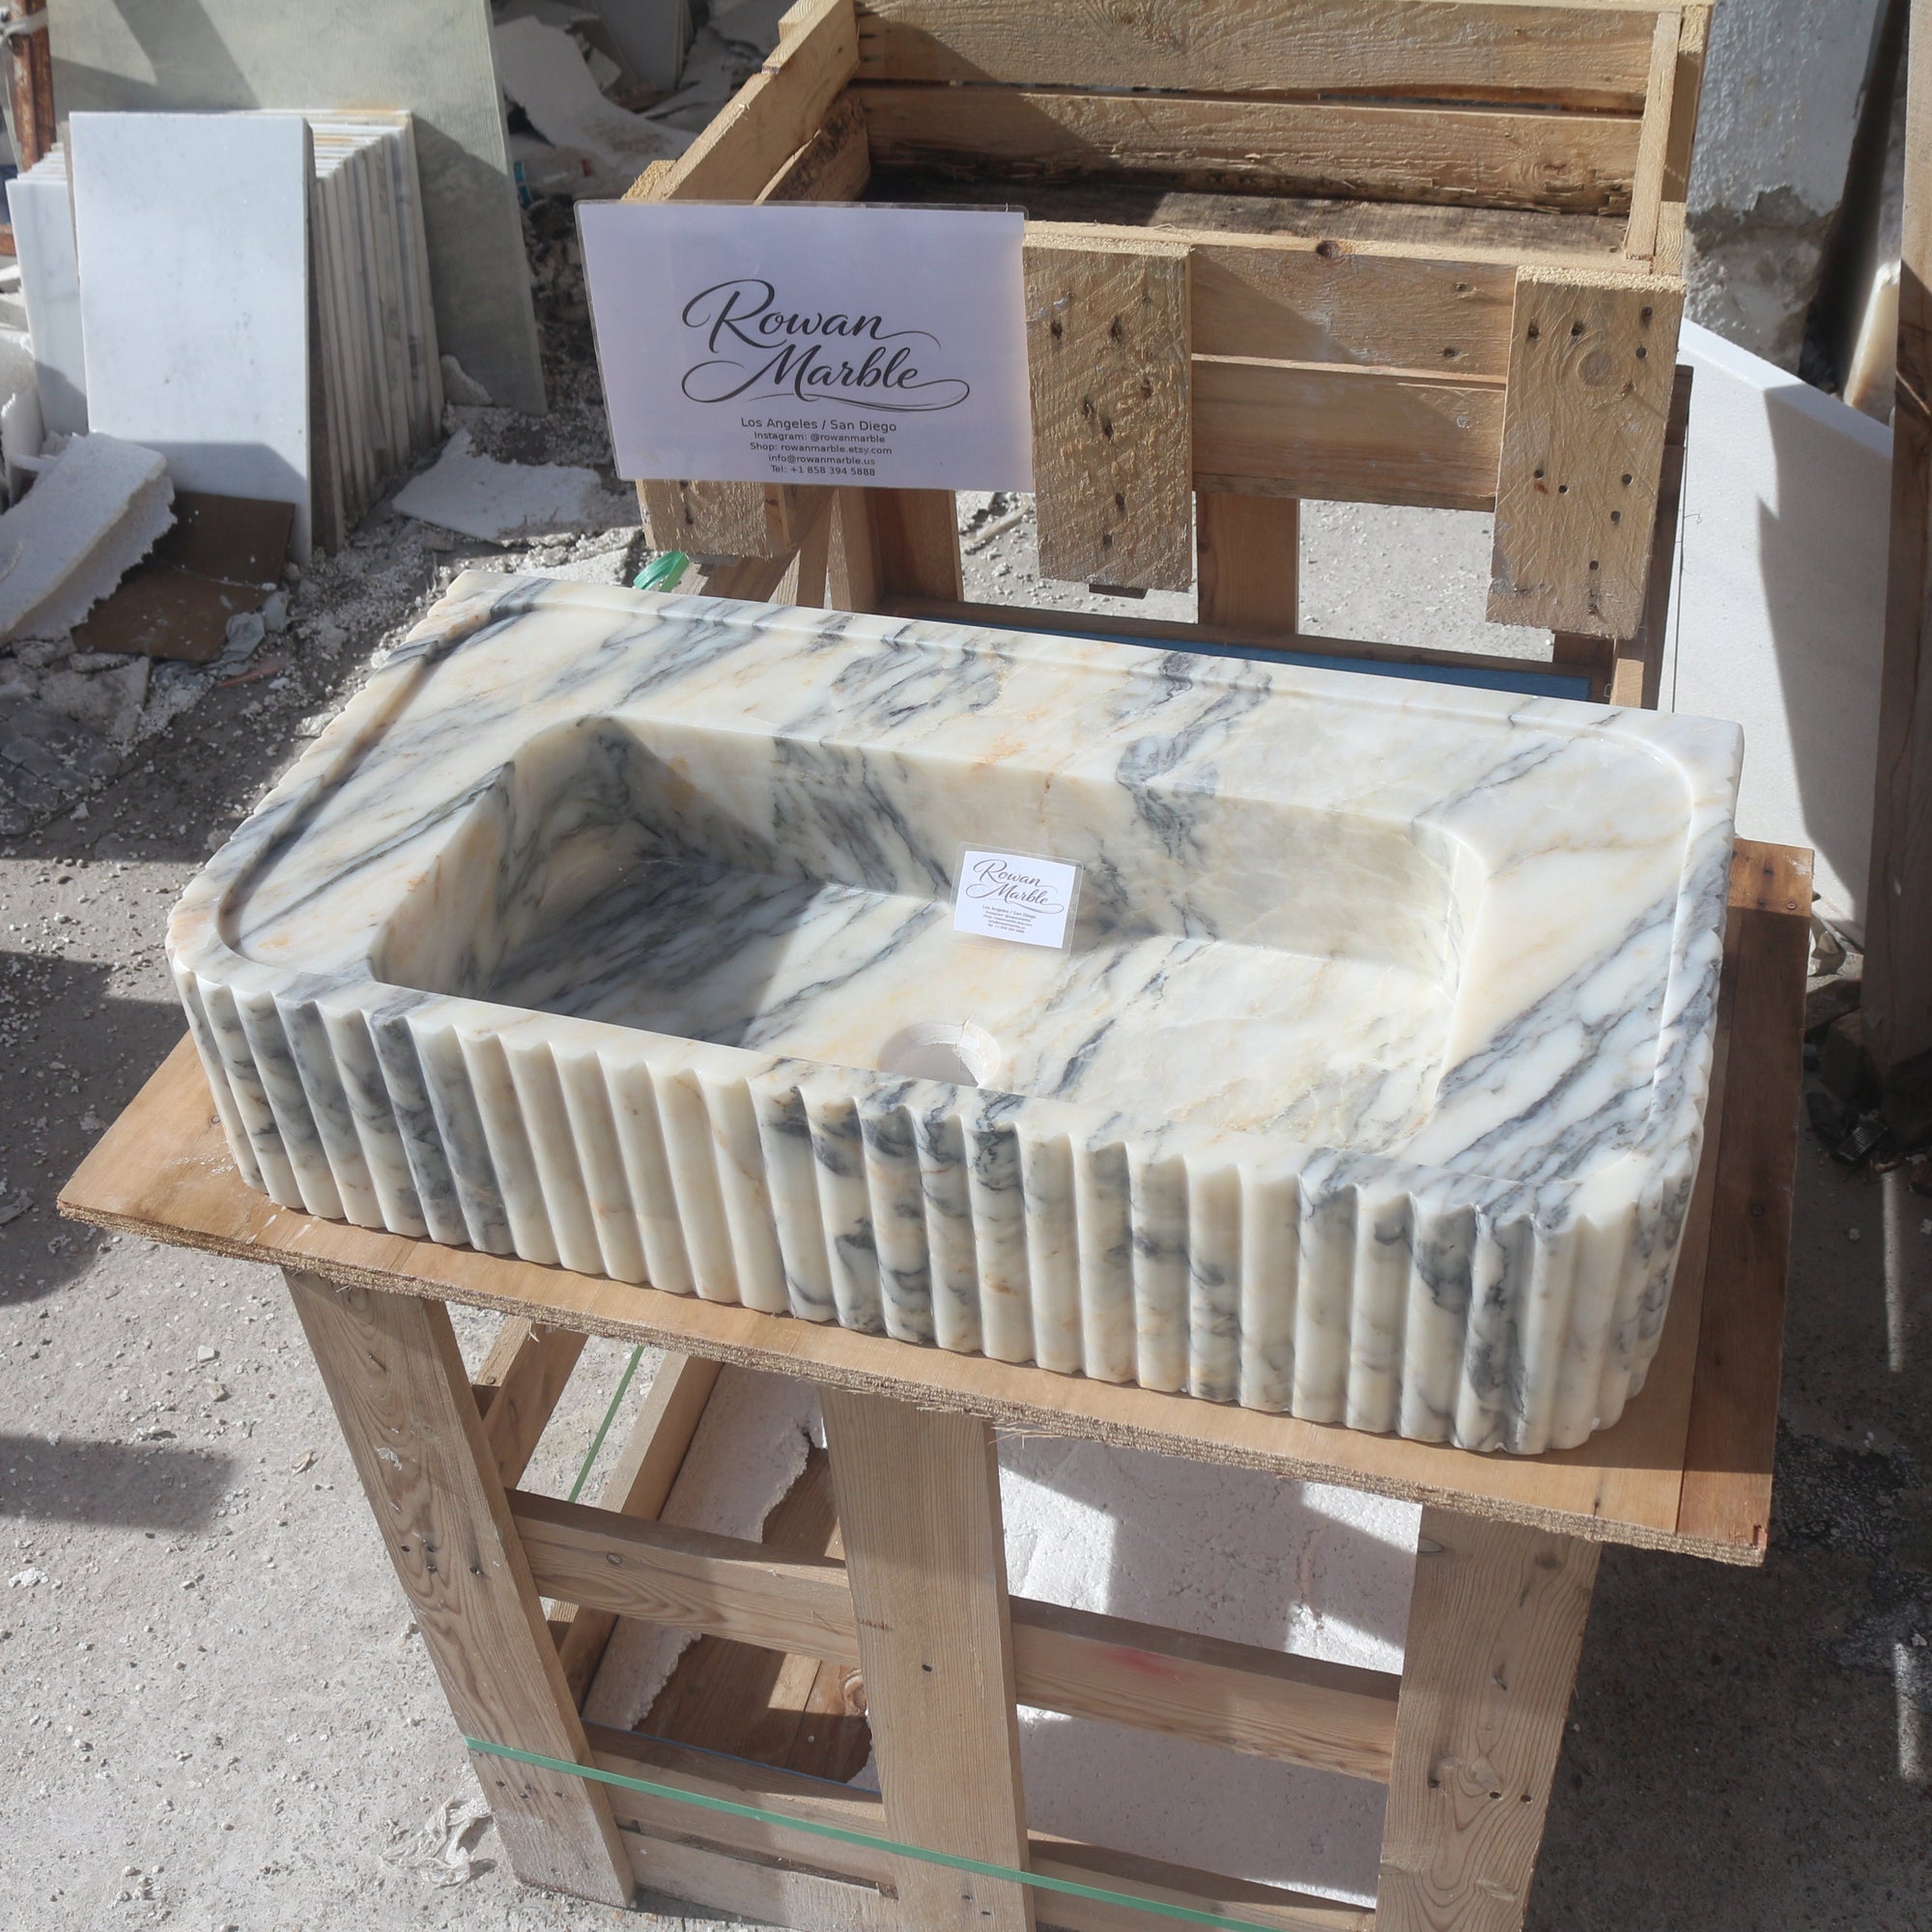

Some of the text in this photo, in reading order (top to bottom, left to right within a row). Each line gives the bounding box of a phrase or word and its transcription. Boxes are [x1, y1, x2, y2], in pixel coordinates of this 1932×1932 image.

[682, 278, 941, 354] Rowan
[681, 344, 970, 412] Marble
[741, 417, 897, 434] Los Angeles / San Diego
[753, 431, 886, 443] Instagram: @rowanmarble
[750, 442, 893, 455] Shop: rowanmarble.etsy.com
[768, 454, 876, 466] info@rowanmarble.us
[770, 465, 876, 476] Tel: +1 858 394 5888
[973, 859, 1058, 894] Rowan
[965, 883, 1065, 914] Marble
